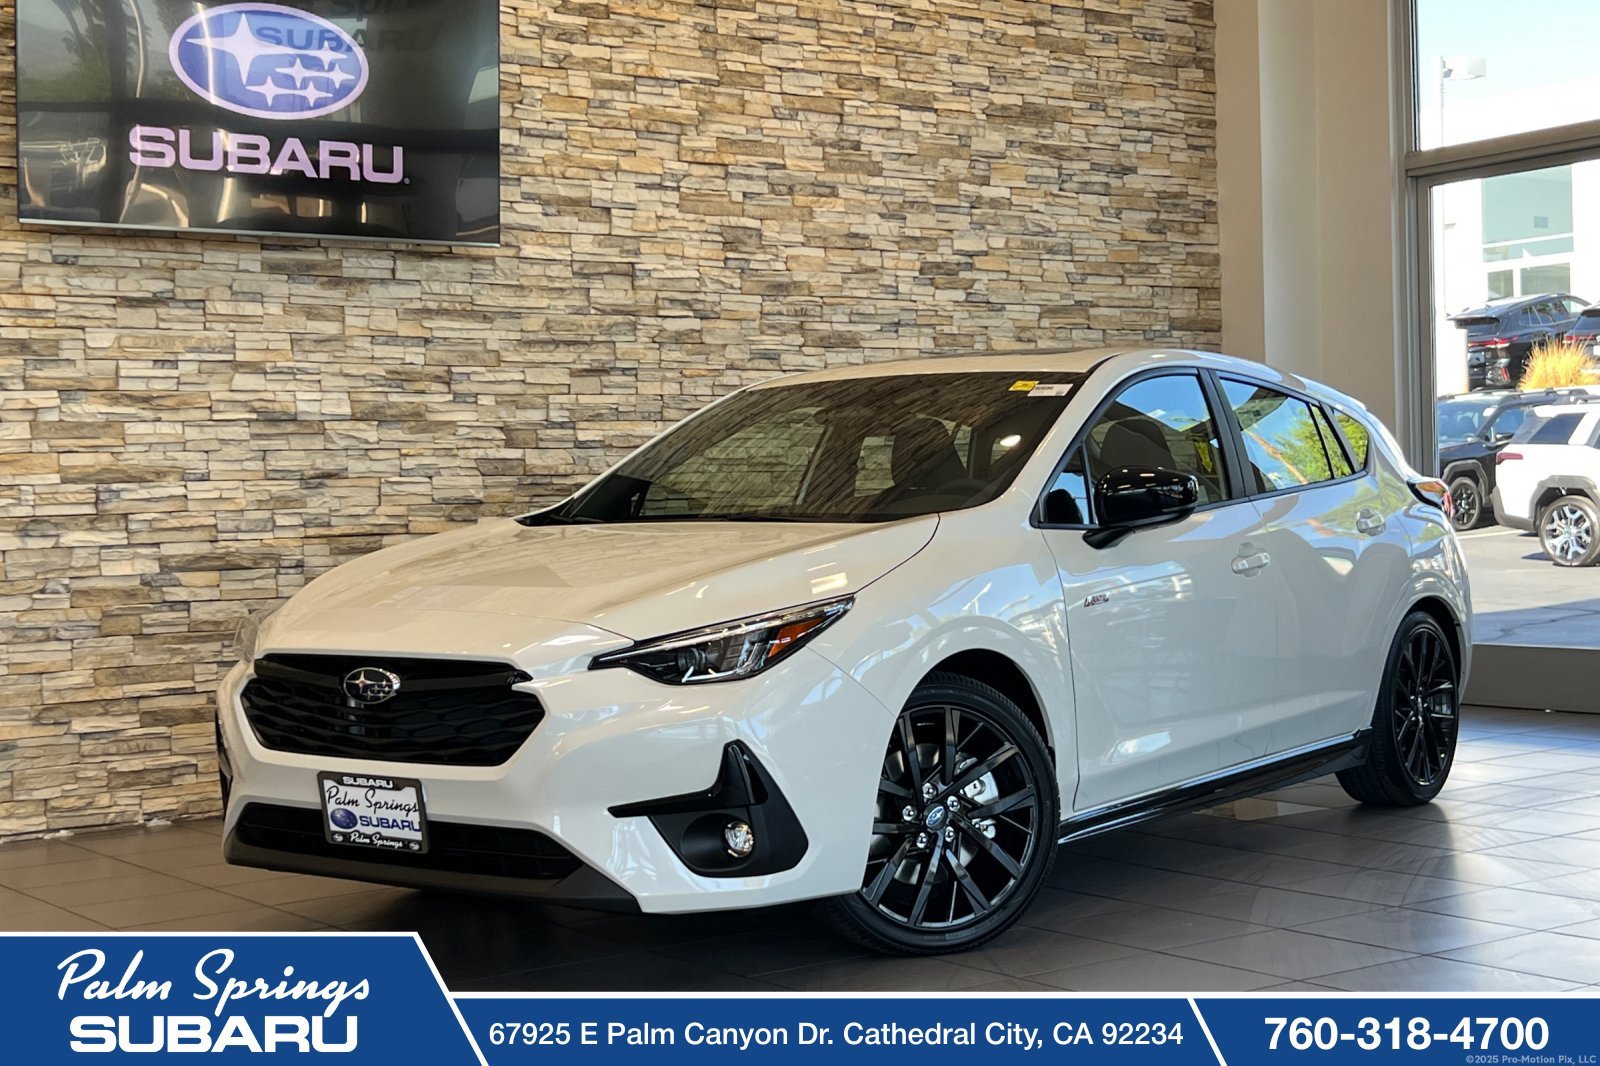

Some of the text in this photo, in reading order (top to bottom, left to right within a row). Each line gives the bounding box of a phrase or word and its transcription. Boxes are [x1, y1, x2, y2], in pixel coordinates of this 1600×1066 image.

[128, 125, 404, 184] SUBARU
[343, 776, 393, 788] SUBARU
[326, 785, 419, 817] Palm Springs
[359, 815, 421, 832] SUBARU
[350, 832, 403, 848] Palm Springs
